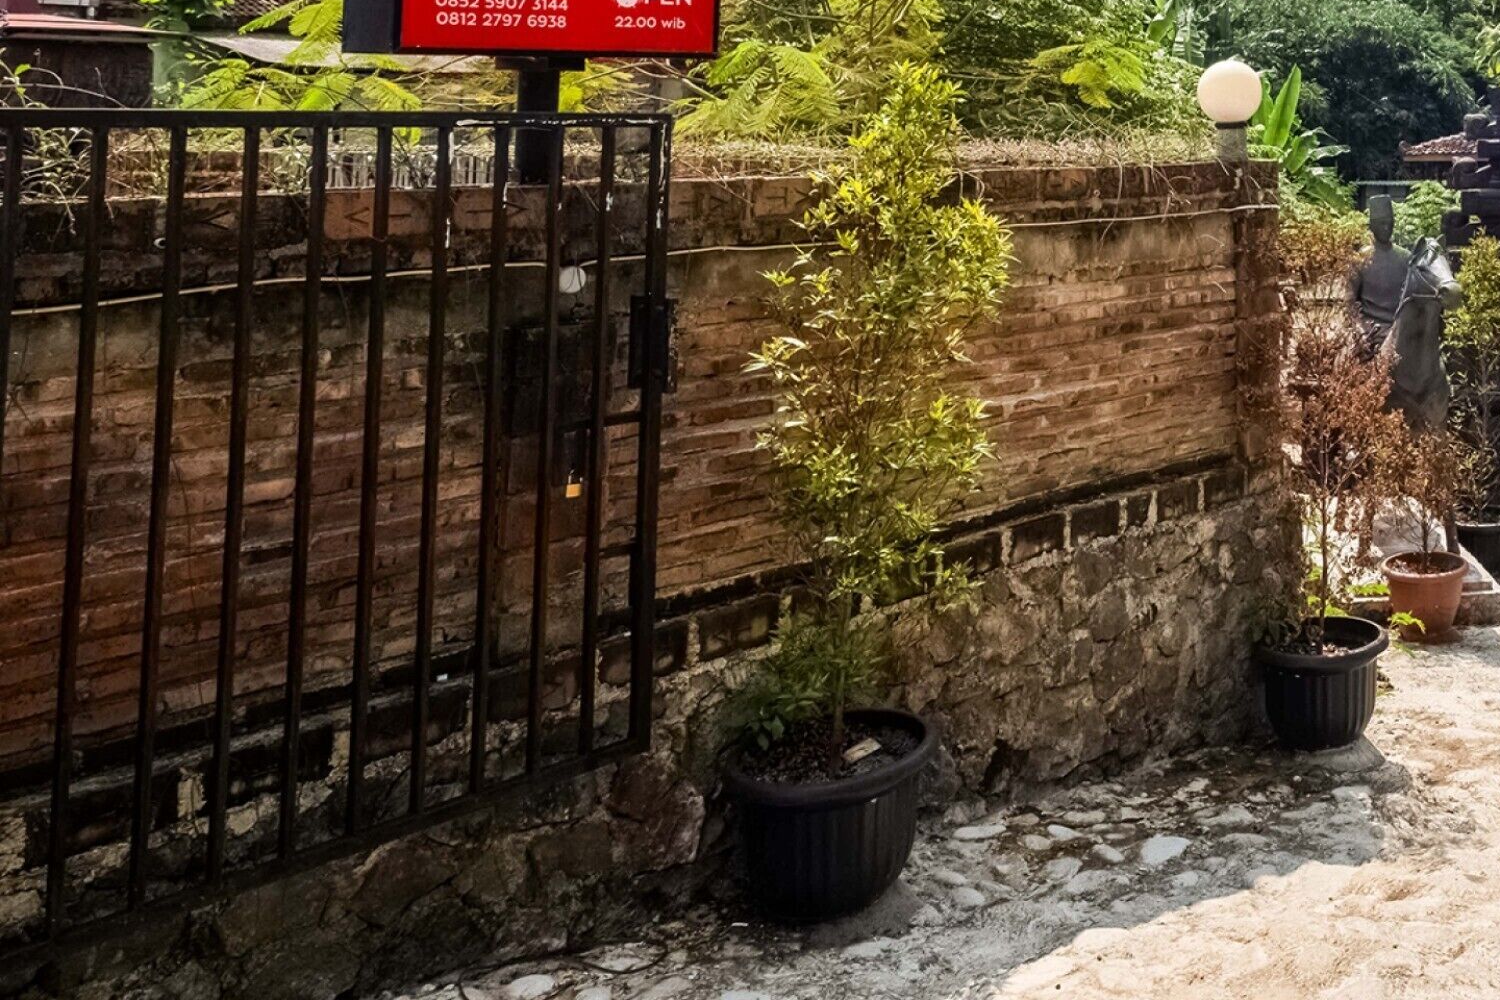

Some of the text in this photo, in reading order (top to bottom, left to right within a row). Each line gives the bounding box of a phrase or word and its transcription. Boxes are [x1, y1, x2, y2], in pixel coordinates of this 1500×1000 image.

[436, 11, 567, 28] 0812 2797 6938
[614, 15, 686, 29] 22.00 wib
